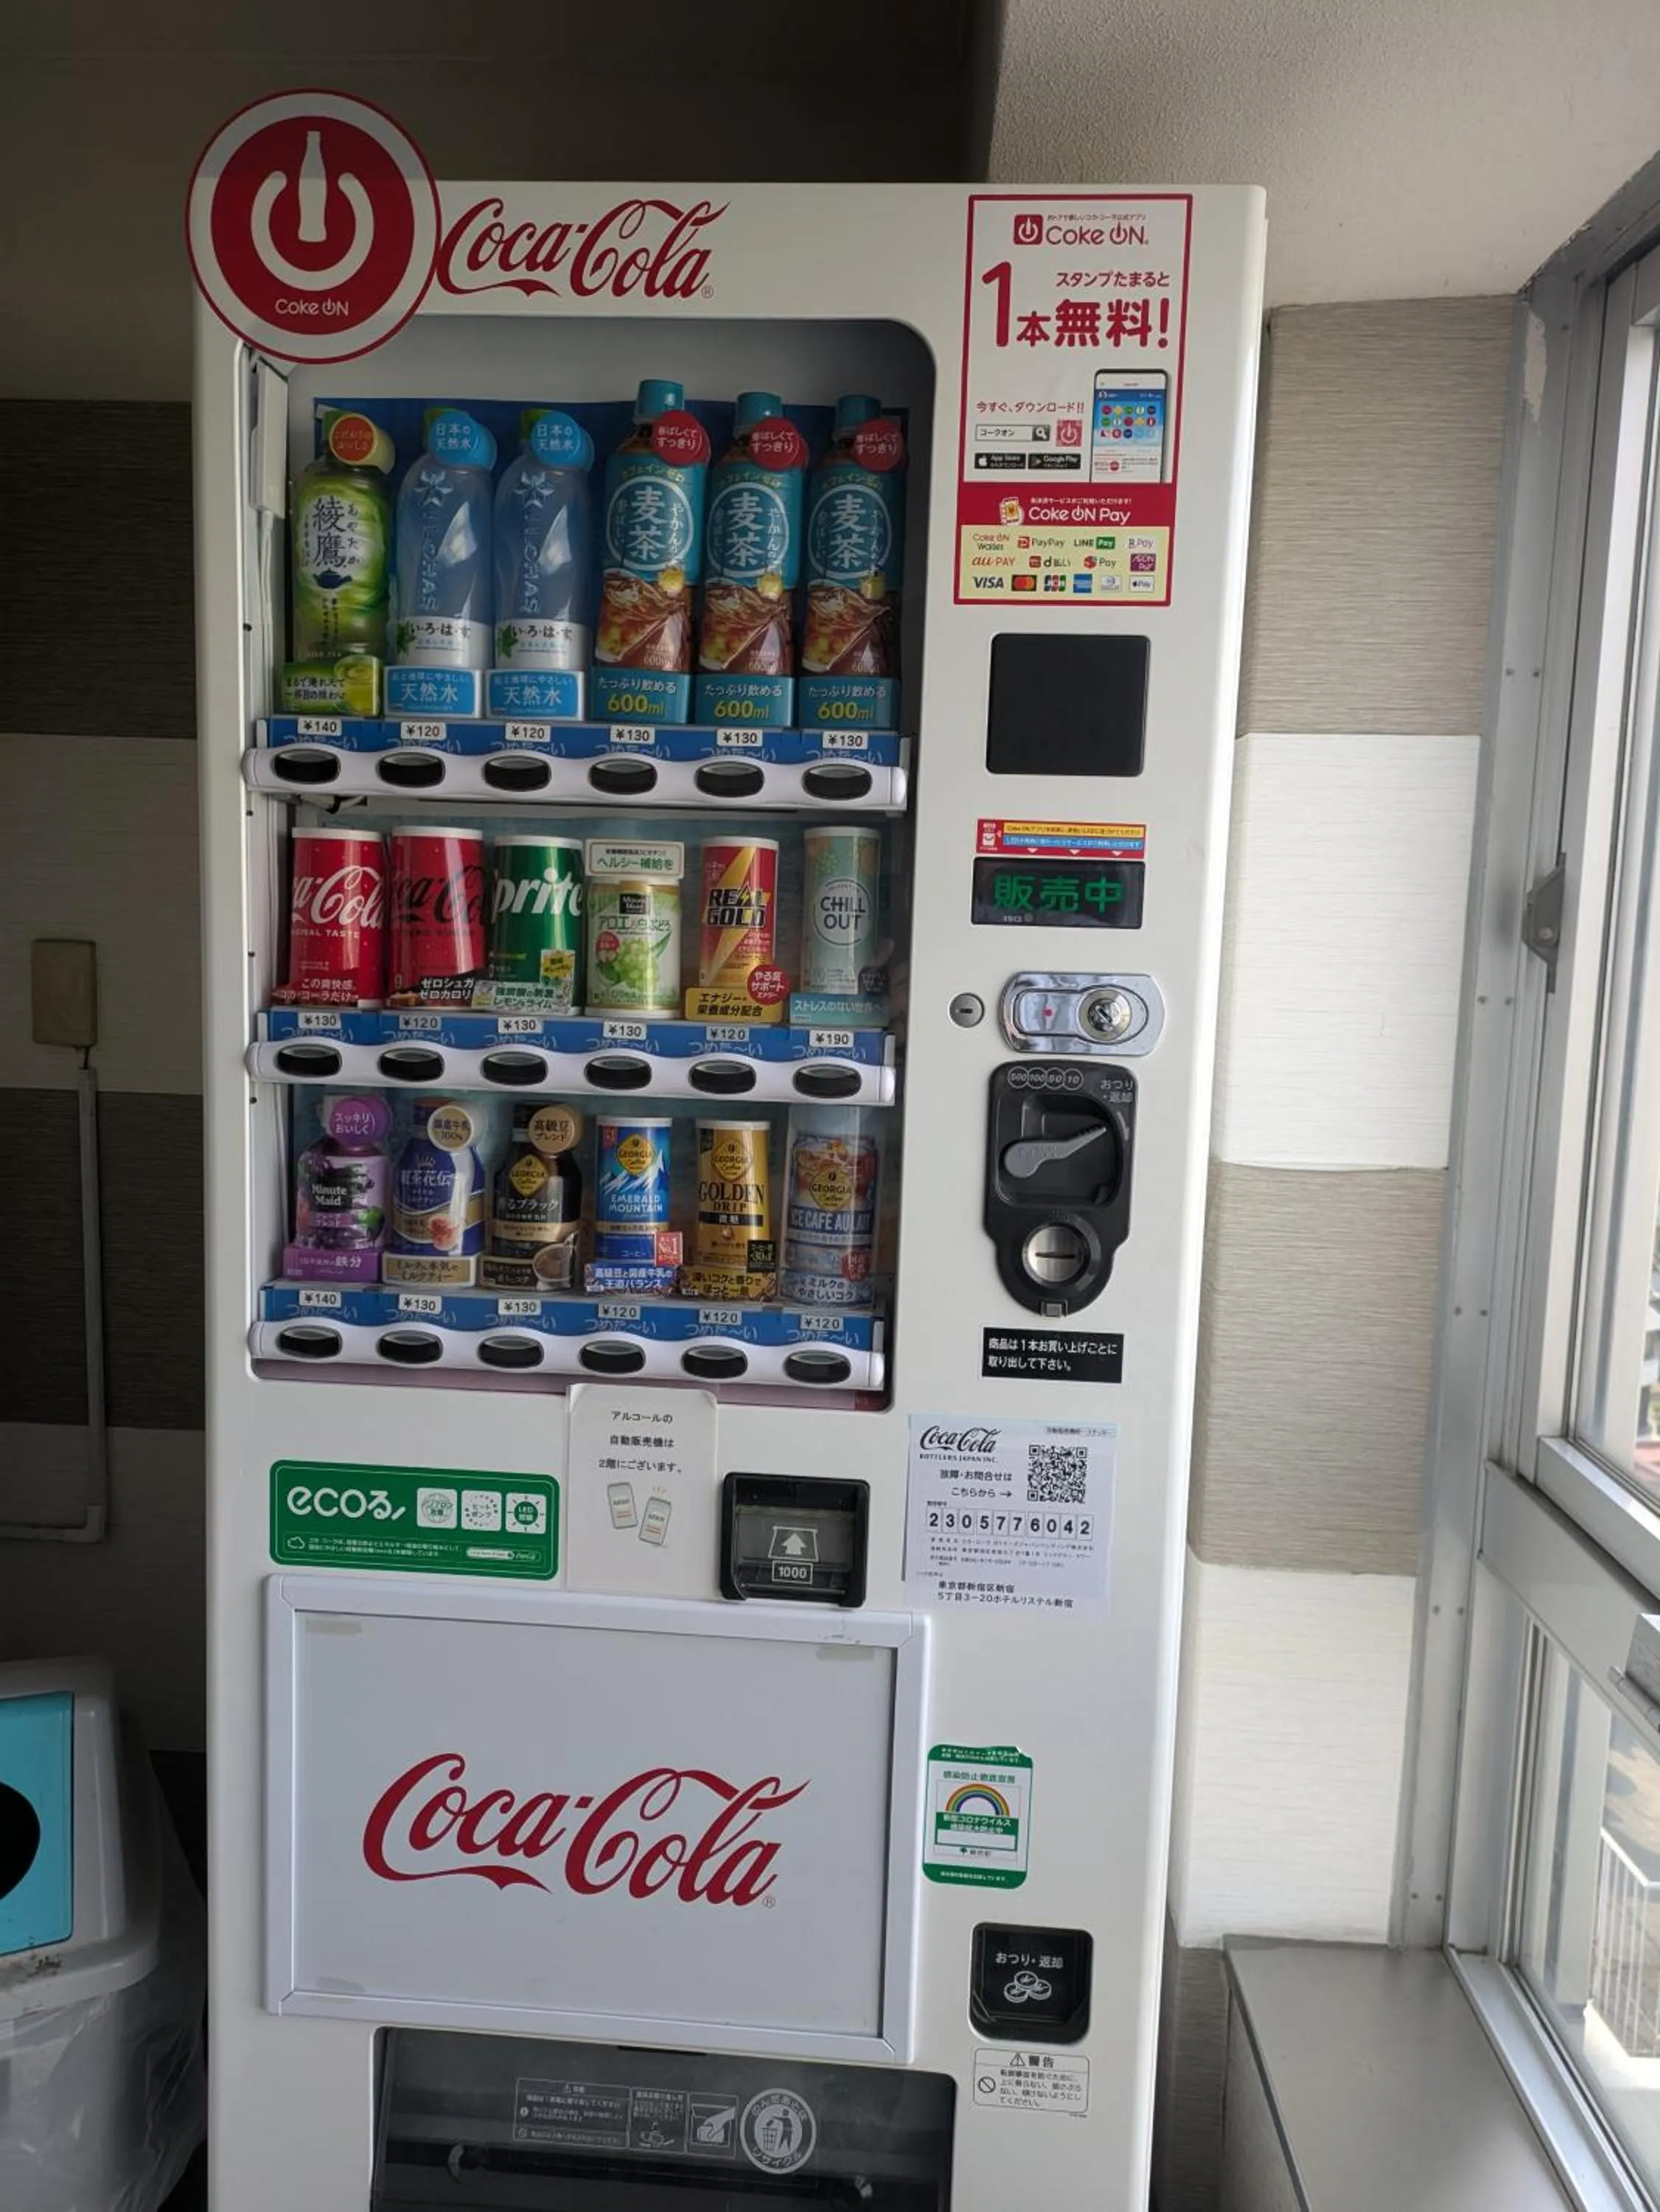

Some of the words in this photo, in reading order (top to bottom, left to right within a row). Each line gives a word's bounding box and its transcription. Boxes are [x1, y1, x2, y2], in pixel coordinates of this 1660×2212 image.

[1046, 226, 1105, 245] Coke
[436, 197, 732, 298] Coca-Cola
[1056, 270, 1170, 288] スタンプたまると
[275, 299, 318, 316] Coke
[323, 297, 349, 316] ON
[436, 423, 472, 435] 日本の
[980, 428, 1015, 437] コークオン
[1028, 507, 1070, 521] Coke
[1071, 505, 1097, 521] ON
[1099, 507, 1131, 525] Pay
[629, 486, 666, 561] 麦茶
[725, 492, 764, 568] 麦茶
[312, 495, 346, 568] 綾鷹
[828, 494, 868, 568] 麦茶
[1031, 538, 1065, 549] PayPay
[1073, 539, 1094, 547] LINE
[1097, 538, 1114, 548] Pay
[995, 557, 1016, 567] PAY
[1098, 557, 1117, 568] Pay
[973, 577, 1005, 589] VISA
[598, 676, 677, 694] たっぷり飲める
[705, 684, 783, 697] たっぷり飲める
[400, 683, 458, 703] 天然水
[503, 686, 562, 706] 天然水
[808, 686, 886, 698] たっぷり飲める
[607, 695, 664, 715] 600ml
[714, 700, 770, 720] 600ml
[817, 702, 874, 720] 600ml
[303, 720, 338, 733] ¥140
[406, 726, 440, 737] ¥120
[512, 727, 545, 739] ¥120
[615, 729, 650, 742] ¥130
[723, 732, 758, 745] ¥130
[828, 734, 863, 747] ¥130
[492, 868, 583, 924] prite
[708, 882, 767, 908] REAL
[995, 874, 1124, 914] 販売中
[819, 896, 866, 915] CHILL
[706, 907, 767, 928] GOLD
[823, 913, 863, 932] OUT
[325, 929, 360, 938] TASTE
[421, 978, 475, 989] ゼロシュガ
[751, 981, 785, 993] サポート
[420, 990, 472, 1001] ゼロカロリ
[696, 1004, 764, 1017] 栄養成分配合
[304, 1015, 337, 1026] ¥130
[402, 1017, 439, 1029] ¥120
[503, 1019, 537, 1031] ¥130
[608, 1025, 643, 1037] ¥130
[709, 1029, 746, 1040] ¥120
[815, 1033, 850, 1045] ¥190
[1101, 1079, 1133, 1091] おつり
[333, 1112, 370, 1125] スッキリ
[534, 1119, 570, 1131] 高級豆
[335, 1124, 370, 1135] おいしく
[534, 1132, 568, 1142] ブレンド
[311, 1183, 349, 1196] Minute
[697, 1183, 765, 1206] GOLDEN
[812, 1183, 852, 1194] GEORGIA
[315, 1194, 342, 1206] Maid
[610, 1193, 660, 1204] EMERALD
[608, 1203, 663, 1214] MOUNTAIN
[712, 1203, 747, 1212] DRIP
[604, 1278, 662, 1290] 王道バランス
[304, 1293, 337, 1305] ¥140
[798, 1287, 854, 1301] やさしいコク
[402, 1298, 436, 1311] ¥130
[503, 1301, 537, 1312] ¥130
[601, 1306, 638, 1318] ¥120
[702, 1312, 738, 1324] ¥120
[803, 1318, 840, 1329] ¥120
[988, 1337, 1117, 1355] 商品は1本お買い上げごとに
[988, 1357, 1072, 1371] 取り出して下さい。
[611, 1411, 673, 1424] アルコールの
[609, 1434, 675, 1449] 自動販売機は
[919, 1425, 1002, 1453] Coca-Cola
[598, 1458, 683, 1474] 2階にございます。
[951, 1487, 996, 1498] こちらから
[777, 1566, 808, 1579] 1000
[938, 1580, 1015, 1593] 東京都新宿区新宿
[363, 1753, 812, 1906] Coca-Cola
[995, 1952, 1064, 1969] おつり・返却
